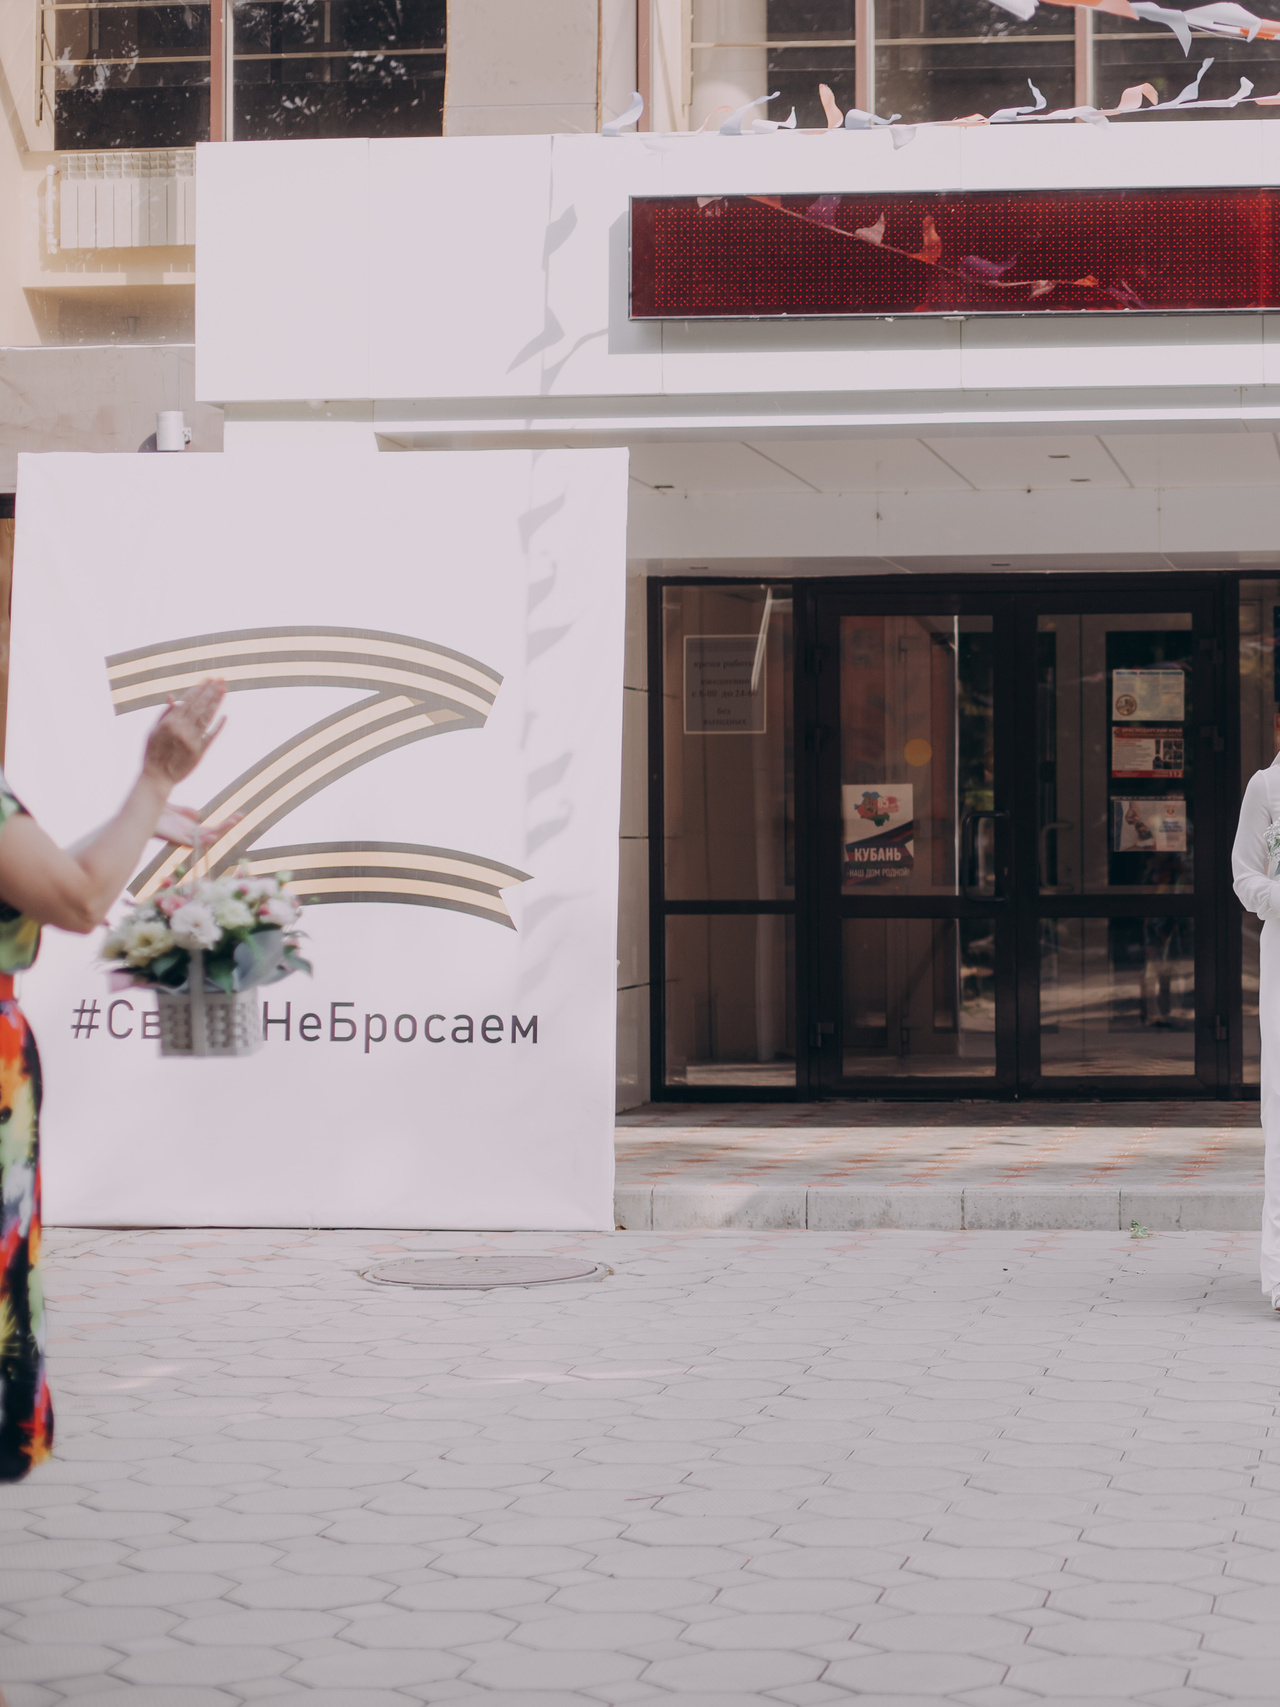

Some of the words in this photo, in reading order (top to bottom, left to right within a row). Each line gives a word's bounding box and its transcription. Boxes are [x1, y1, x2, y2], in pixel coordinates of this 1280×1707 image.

[854, 847, 902, 862] КУБАНЬ
[866, 868, 880, 878] ДОМ
[882, 866, 910, 878] РОДНОЙ!
[71, 998, 539, 1054] #СвНеБросаем
